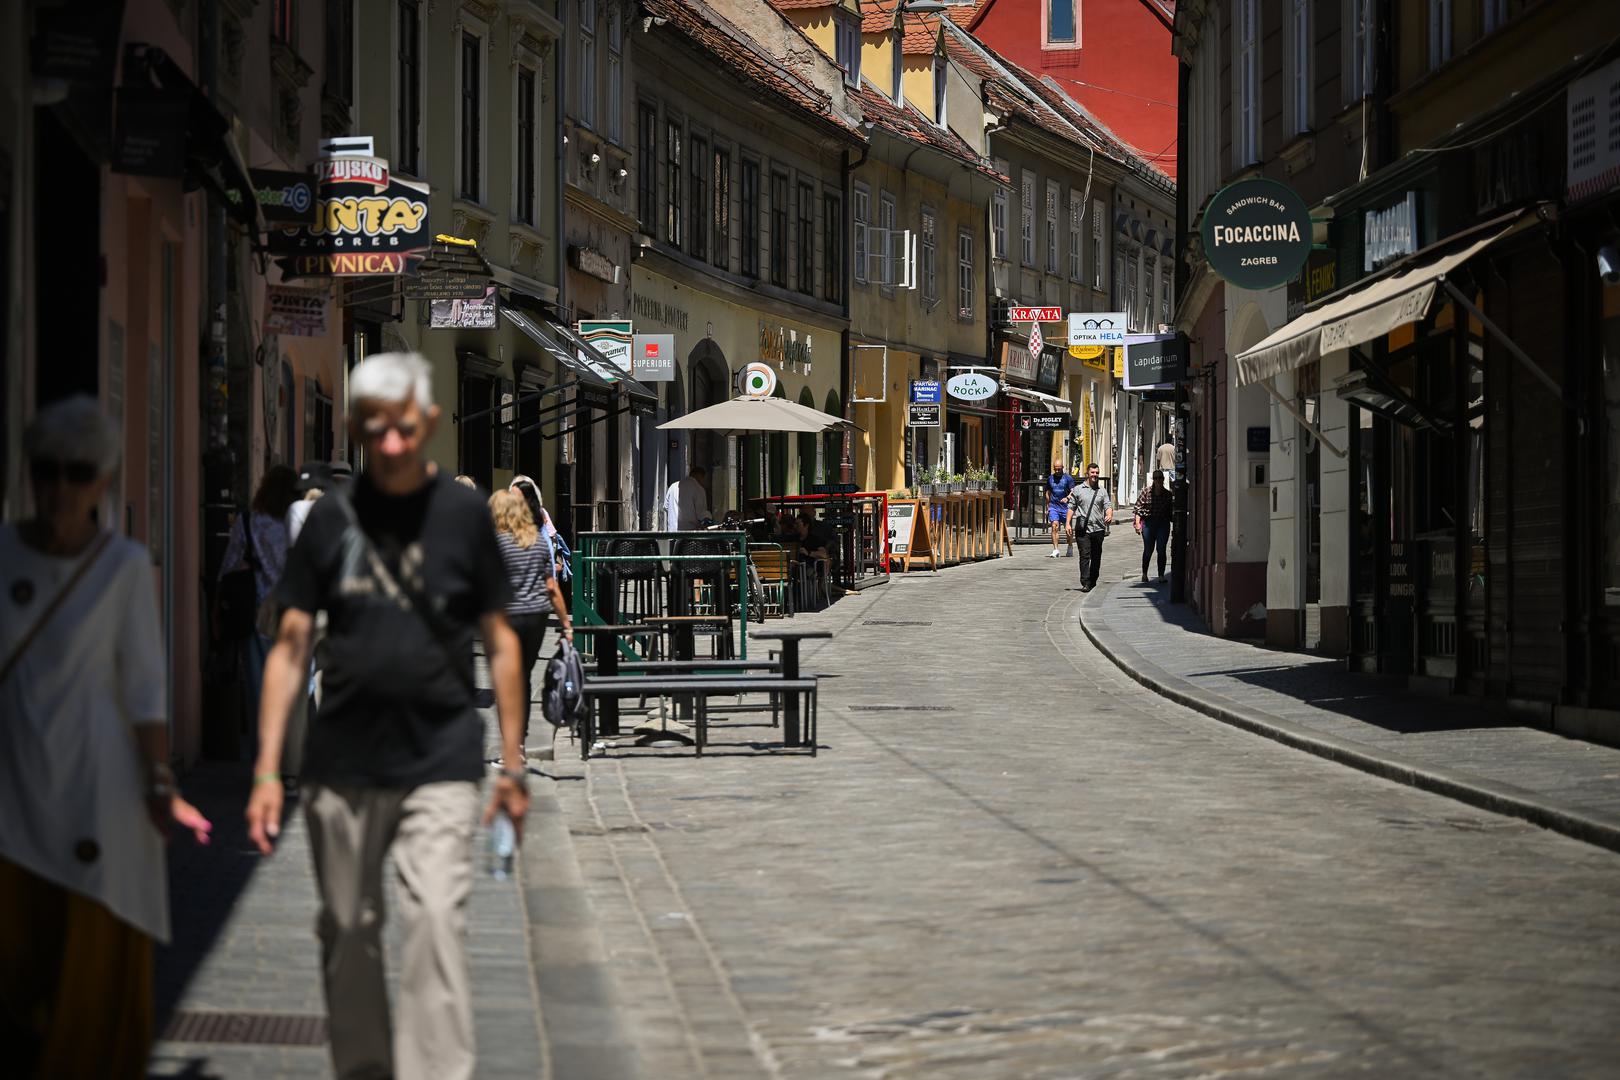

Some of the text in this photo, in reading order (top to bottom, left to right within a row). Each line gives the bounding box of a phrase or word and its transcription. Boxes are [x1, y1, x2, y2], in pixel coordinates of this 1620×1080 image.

[1226, 196, 1286, 215] SANDWICH BAR
[306, 197, 428, 236] INTA
[1214, 221, 1301, 247] FOCACCINA
[299, 236, 400, 246] ZAGREB
[1241, 256, 1278, 266] ZAGREB
[1011, 308, 1061, 321] KRAVATA
[633, 359, 672, 368] SUPERIORE
[1134, 353, 1178, 368] Lapidarium
[953, 386, 989, 396] ROCKA
